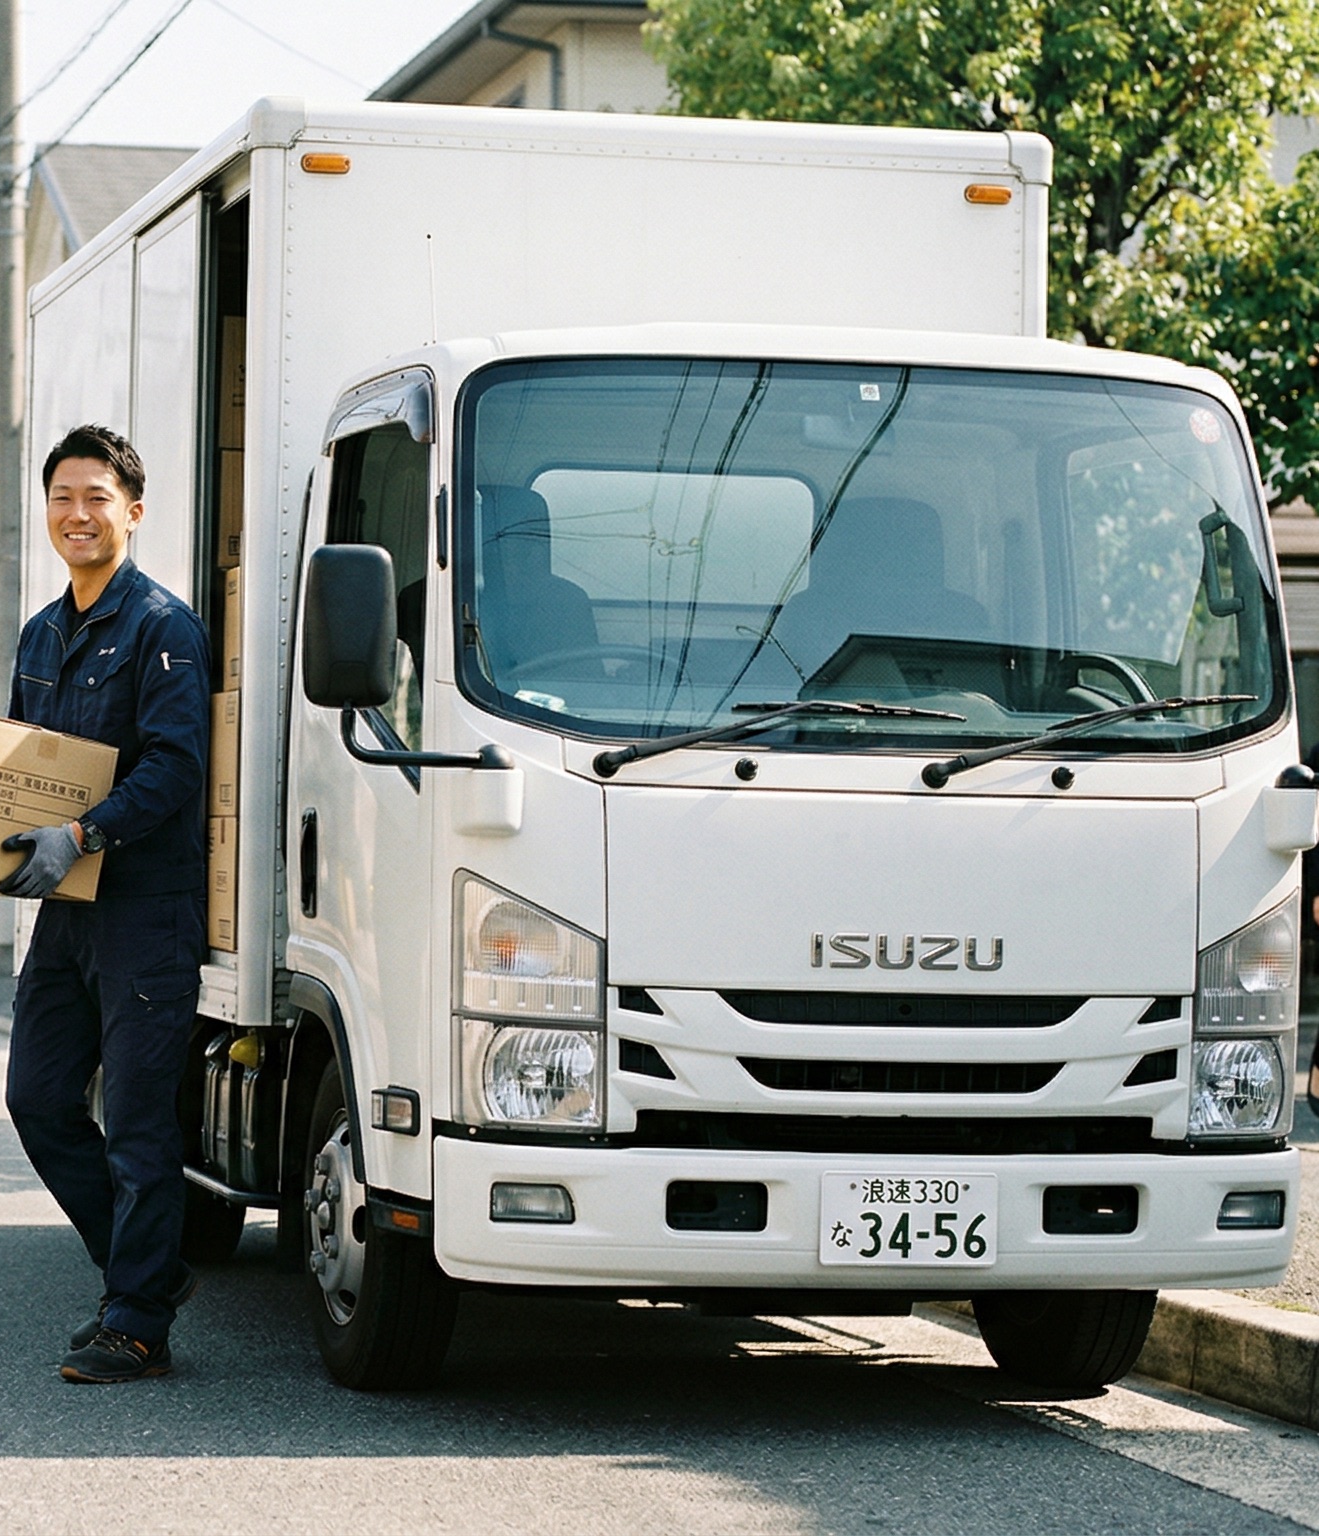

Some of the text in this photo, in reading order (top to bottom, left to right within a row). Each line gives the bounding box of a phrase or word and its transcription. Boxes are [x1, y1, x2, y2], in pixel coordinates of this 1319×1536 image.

[811, 932, 1003, 971] ISUZU
[862, 1178, 959, 1204] 浪速330
[831, 1211, 987, 1259] な 34-56
